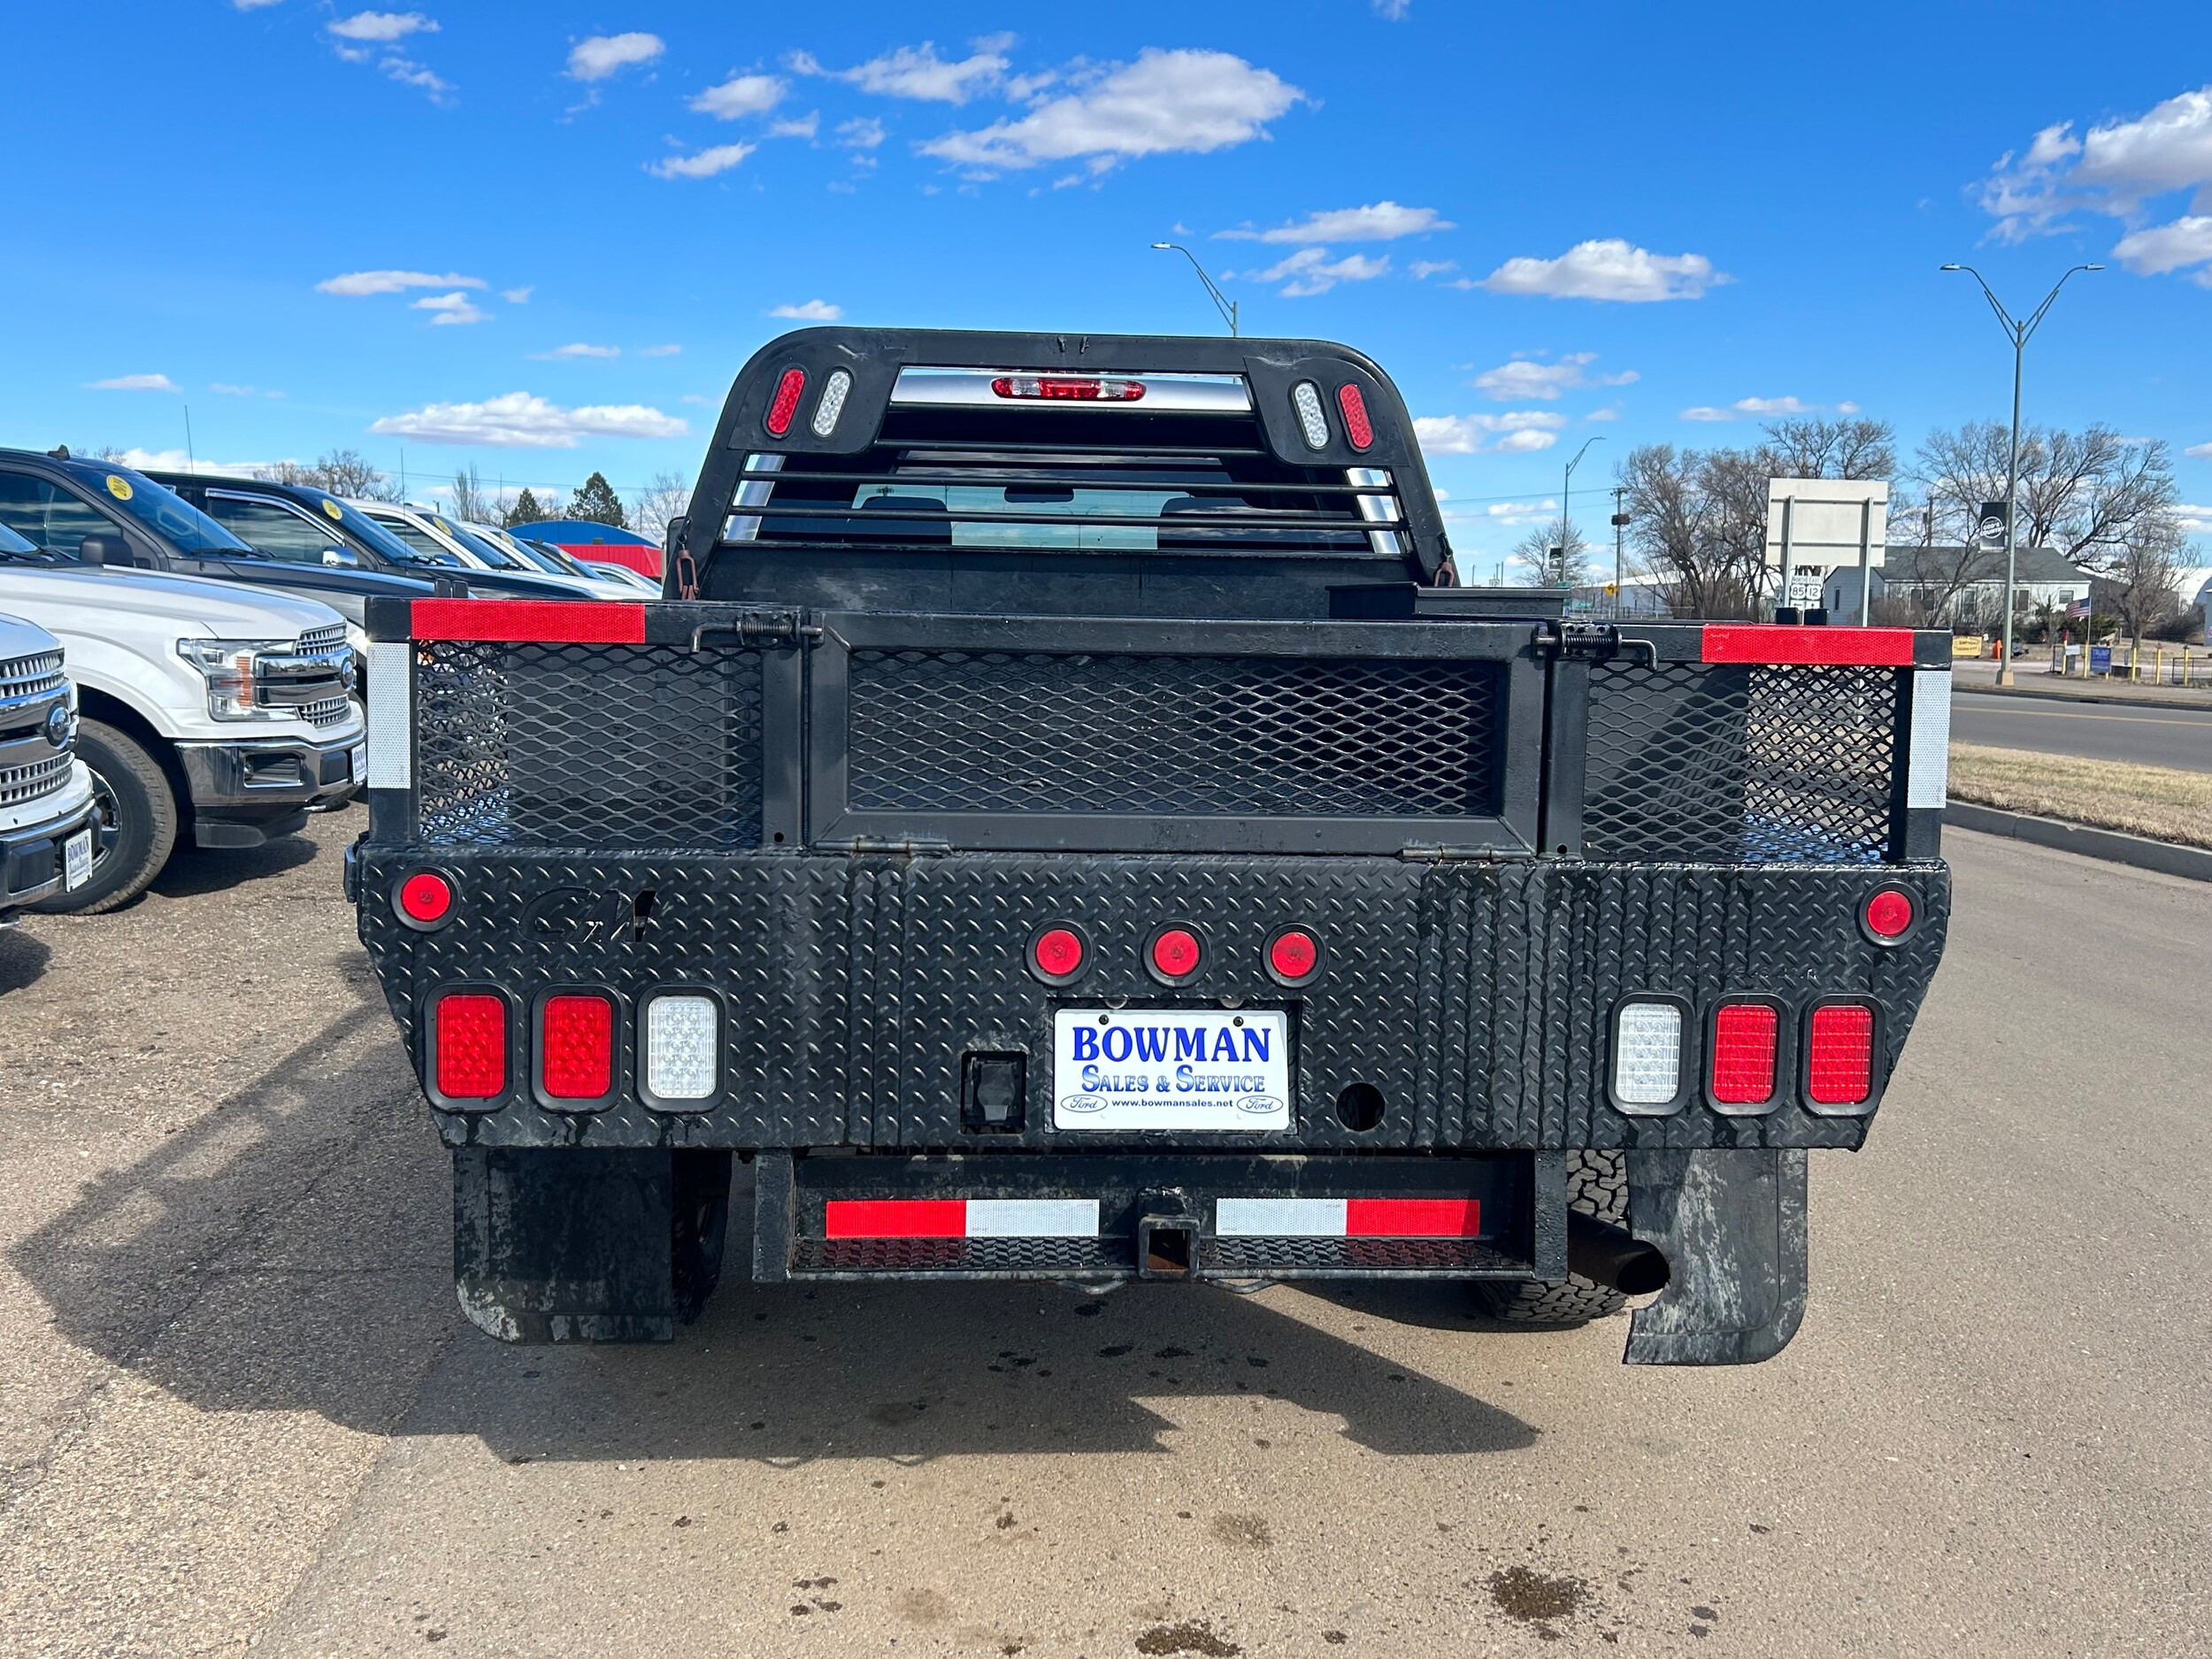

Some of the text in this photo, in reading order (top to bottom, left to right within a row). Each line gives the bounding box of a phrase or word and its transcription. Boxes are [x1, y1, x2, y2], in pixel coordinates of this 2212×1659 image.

[1792, 587, 1804, 596] 85
[1809, 588, 1818, 597] 12
[1072, 1026, 1271, 1062] BOWMAN
[1081, 1064, 1265, 1093] SALES & SERVICE
[1070, 1096, 1097, 1110] Ford
[1111, 1098, 1233, 1108] www.bowmansales.net
[1245, 1096, 1274, 1110] Ford
